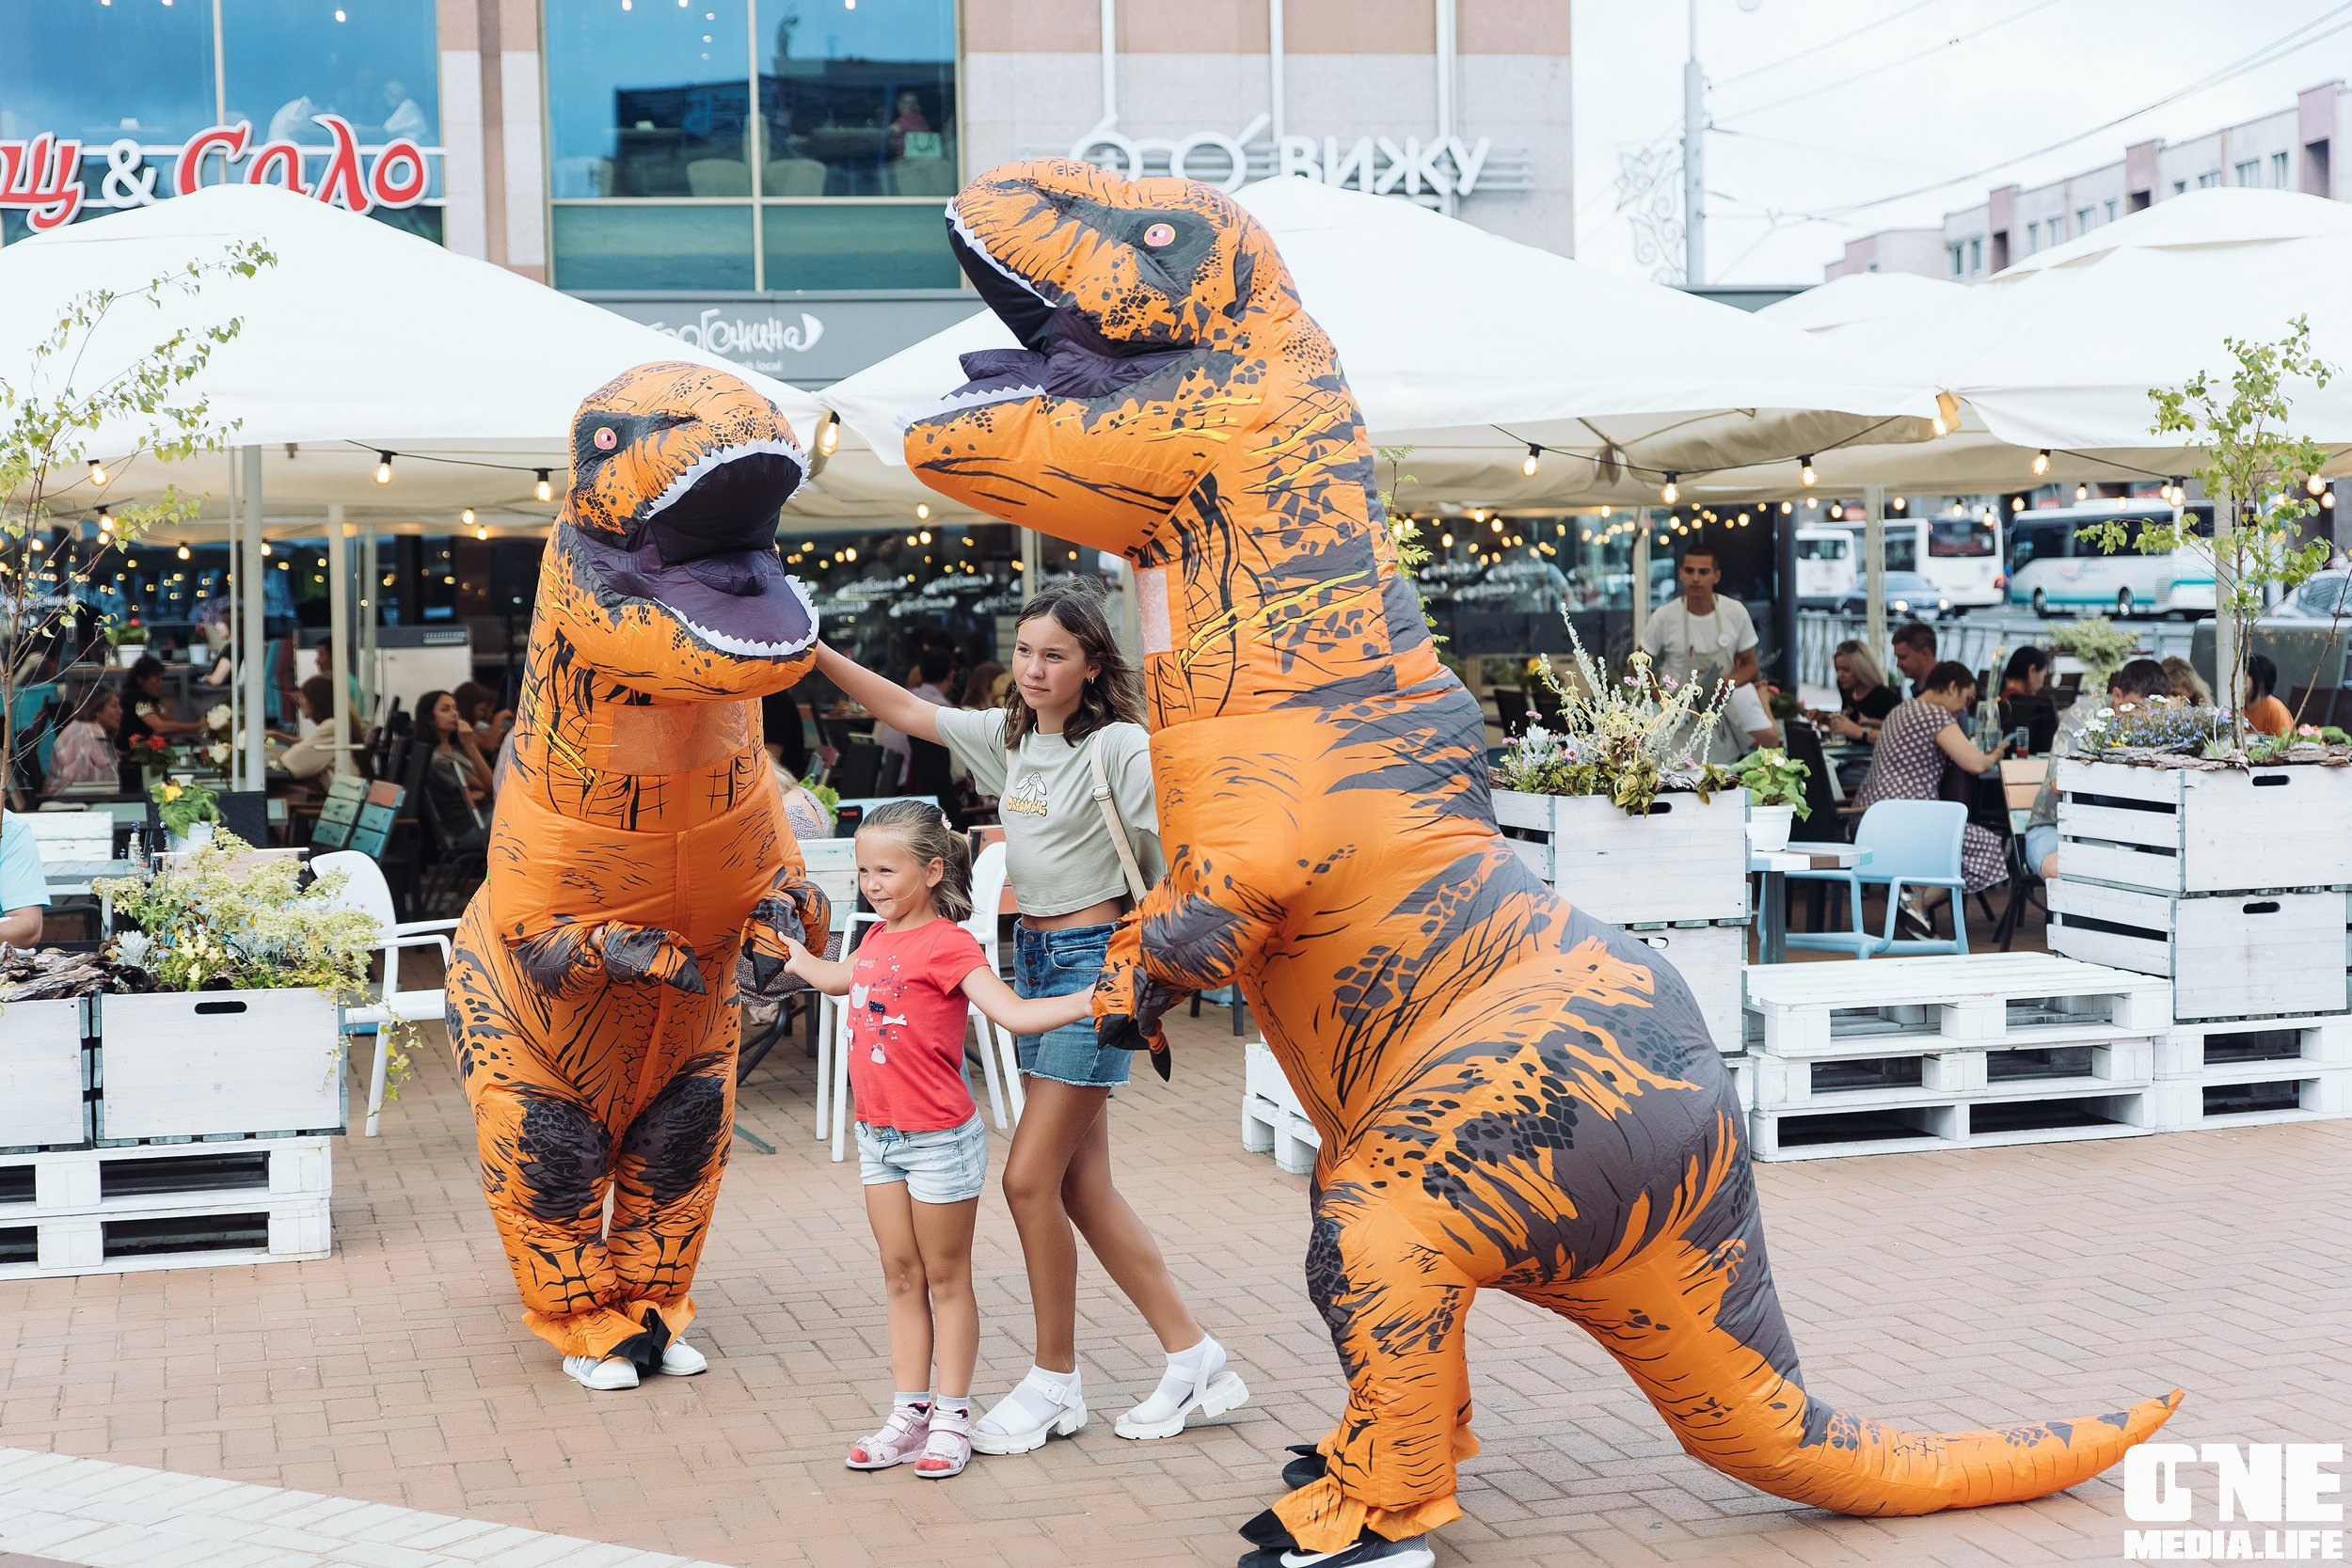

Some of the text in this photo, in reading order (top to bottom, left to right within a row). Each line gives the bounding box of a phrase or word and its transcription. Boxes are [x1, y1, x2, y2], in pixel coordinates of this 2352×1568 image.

[101, 139, 158, 208] &
[173, 113, 431, 216] Сало
[1279, 135, 1492, 197] ВИЖУ
